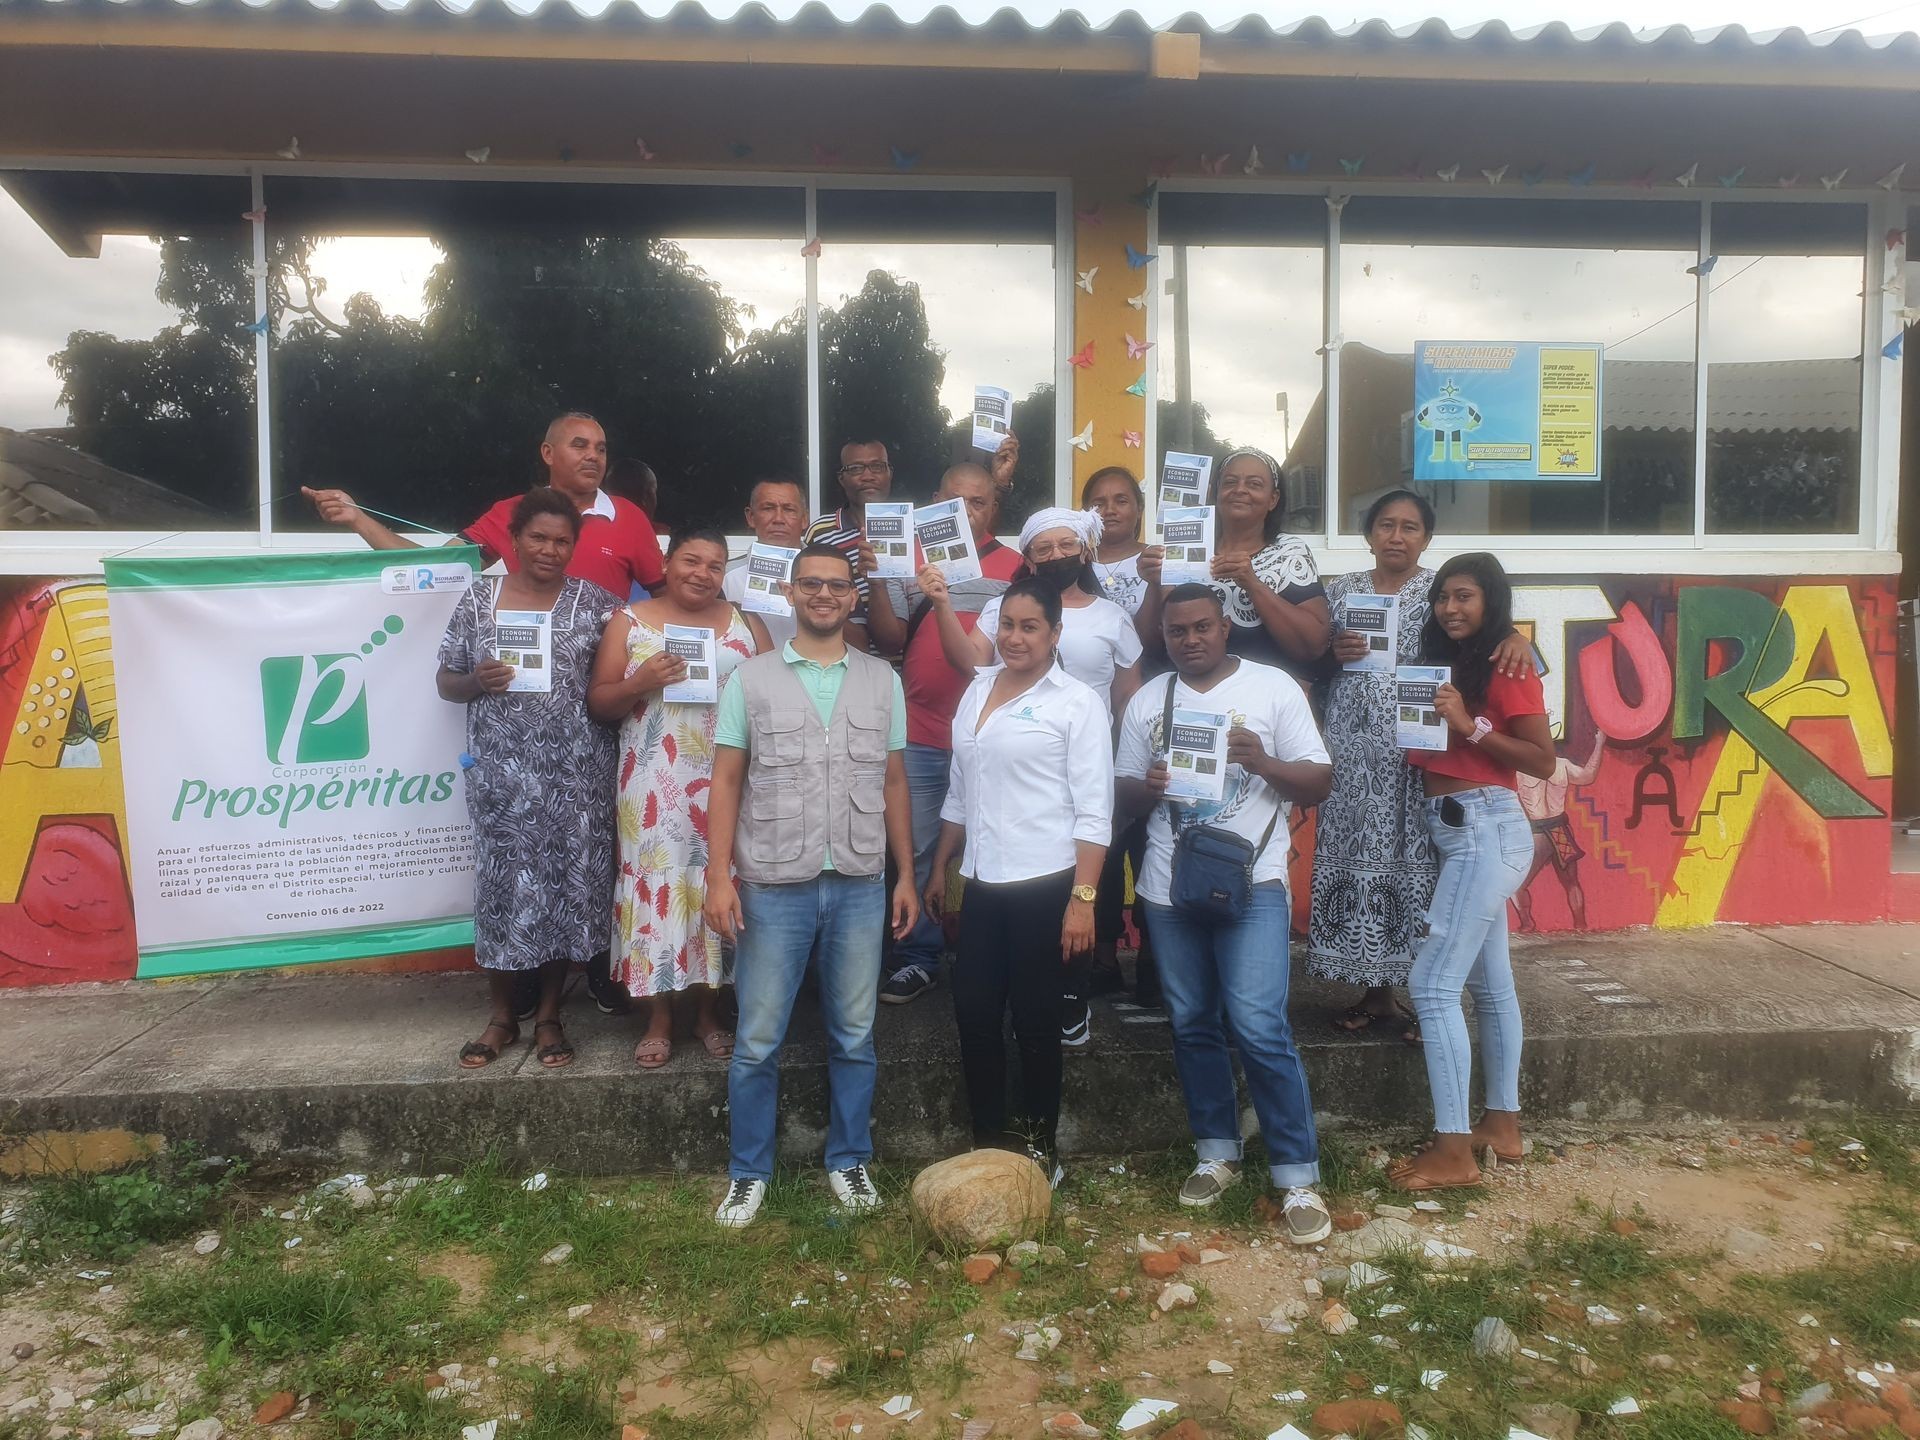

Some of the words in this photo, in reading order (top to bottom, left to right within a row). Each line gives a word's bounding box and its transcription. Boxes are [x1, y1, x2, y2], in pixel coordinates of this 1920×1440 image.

[1168, 469, 1194, 477] ECONOMIA
[922, 522, 951, 533] ECONOMIA
[923, 528, 953, 539] SOLIDARIA
[754, 560, 782, 568] ECONOMIA
[1176, 736, 1209, 744] SOLIDARIA
[1177, 729, 1210, 738] ECONOMIA
[272, 762, 367, 780] Corporación
[171, 767, 457, 829] Prospéritas
[157, 847, 191, 856] Anuar
[198, 842, 251, 853] esfuerzos
[257, 835, 347, 850] administrativos,
[353, 831, 398, 841] técnicos
[404, 830, 411, 838] y
[158, 859, 183, 868] para
[187, 856, 197, 864] el
[200, 850, 286, 863] fortalecimiento
[289, 848, 303, 856] de
[306, 846, 322, 855] las
[325, 842, 374, 853] unidades
[377, 835, 441, 850] productivas
[444, 834, 457, 843] de
[159, 868, 189, 877] llinas
[193, 862, 252, 876] ponedoras
[256, 861, 280, 870] para
[284, 859, 294, 867] la
[298, 853, 352, 868] población
[356, 852, 390, 863] negra,
[160, 878, 191, 887] raizal
[207, 872, 269, 885] palenquera
[274, 871, 295, 880] que
[300, 864, 350, 878] permitan
[354, 864, 364, 872] el
[369, 855, 444, 871] mejoramiento
[449, 854, 462, 863] de
[160, 888, 202, 898] calidad
[206, 885, 220, 894] de
[224, 883, 247, 893] vida
[251, 883, 265, 891] en
[269, 881, 279, 889] el
[283, 878, 324, 888] Distrito
[328, 874, 376, 887] especial,
[379, 868, 425, 880] turístico
[428, 869, 435, 877] y
[290, 889, 303, 898] de
[307, 885, 357, 897] riohacha.
[266, 909, 318, 921] Convenio
[321, 907, 339, 916] 016
[342, 905, 356, 914] de
[359, 903, 385, 912] 2022
